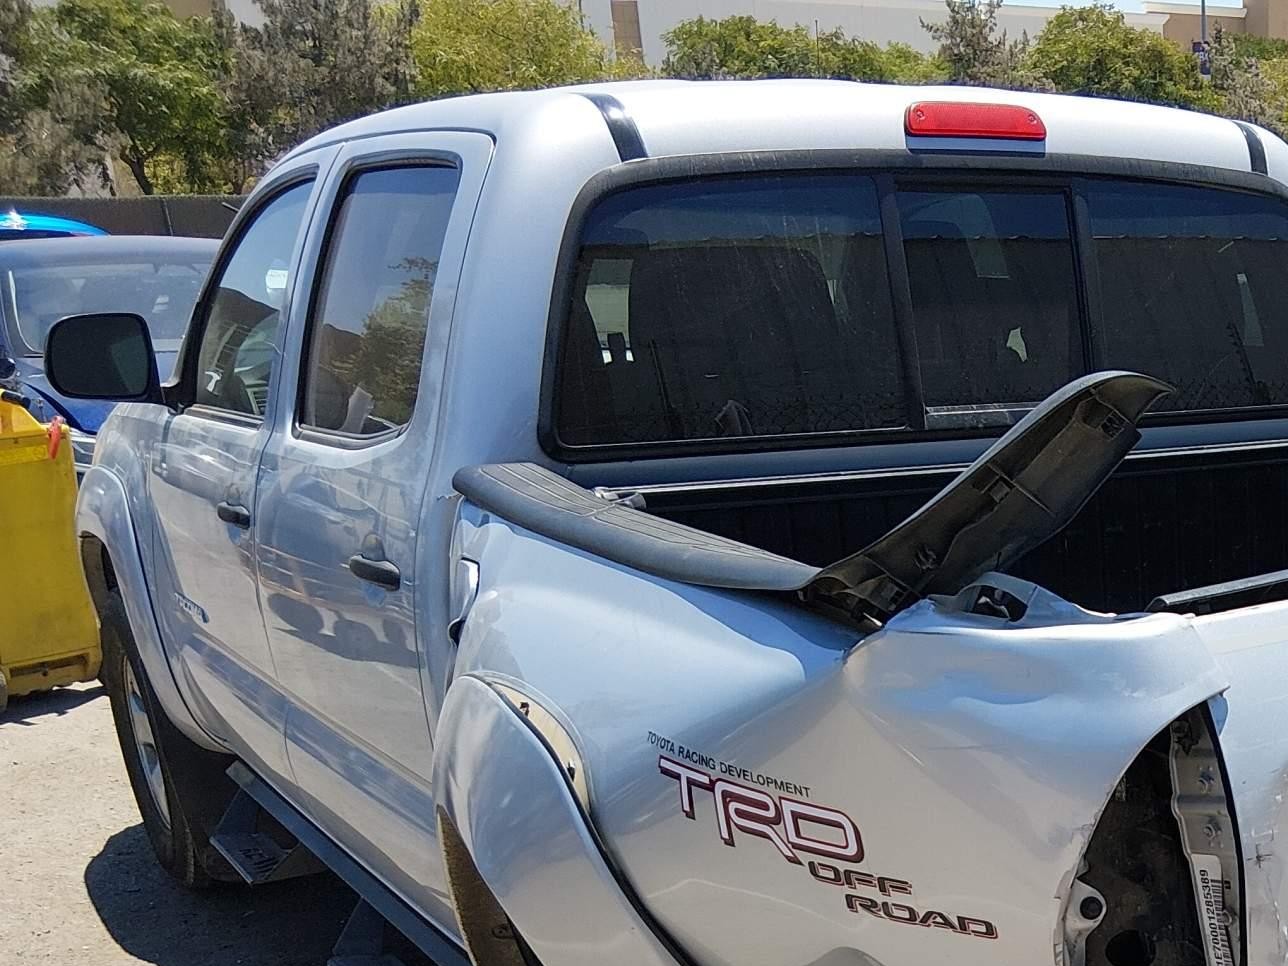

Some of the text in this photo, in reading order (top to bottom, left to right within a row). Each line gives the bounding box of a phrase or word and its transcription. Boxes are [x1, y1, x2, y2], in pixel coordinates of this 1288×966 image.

[646, 730, 811, 799] TOYOTA RACING DEVELOPMENT
[658, 754, 865, 866] TRD
[807, 860, 913, 897] OFF
[844, 893, 1000, 940] ROAD
